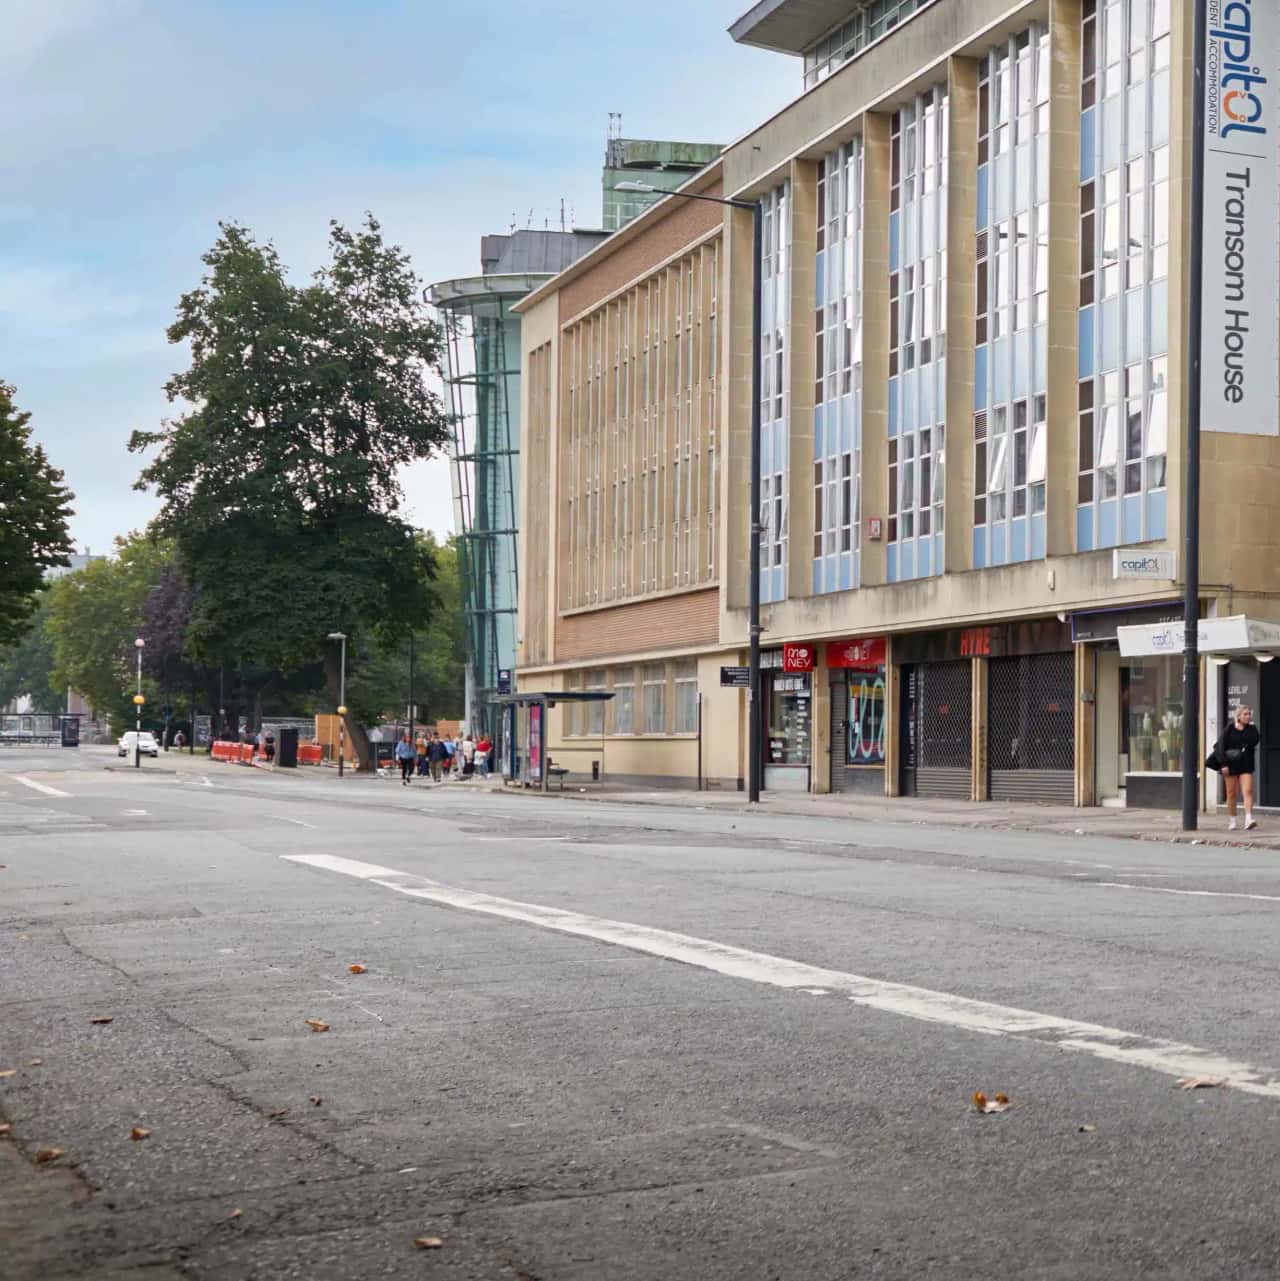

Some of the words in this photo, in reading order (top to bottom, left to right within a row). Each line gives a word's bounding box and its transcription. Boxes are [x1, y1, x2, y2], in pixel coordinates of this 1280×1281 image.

[1207, 38, 1218, 135] ACCOMMODATION
[1224, 167, 1251, 301] Transom
[1223, 309, 1250, 404] House
